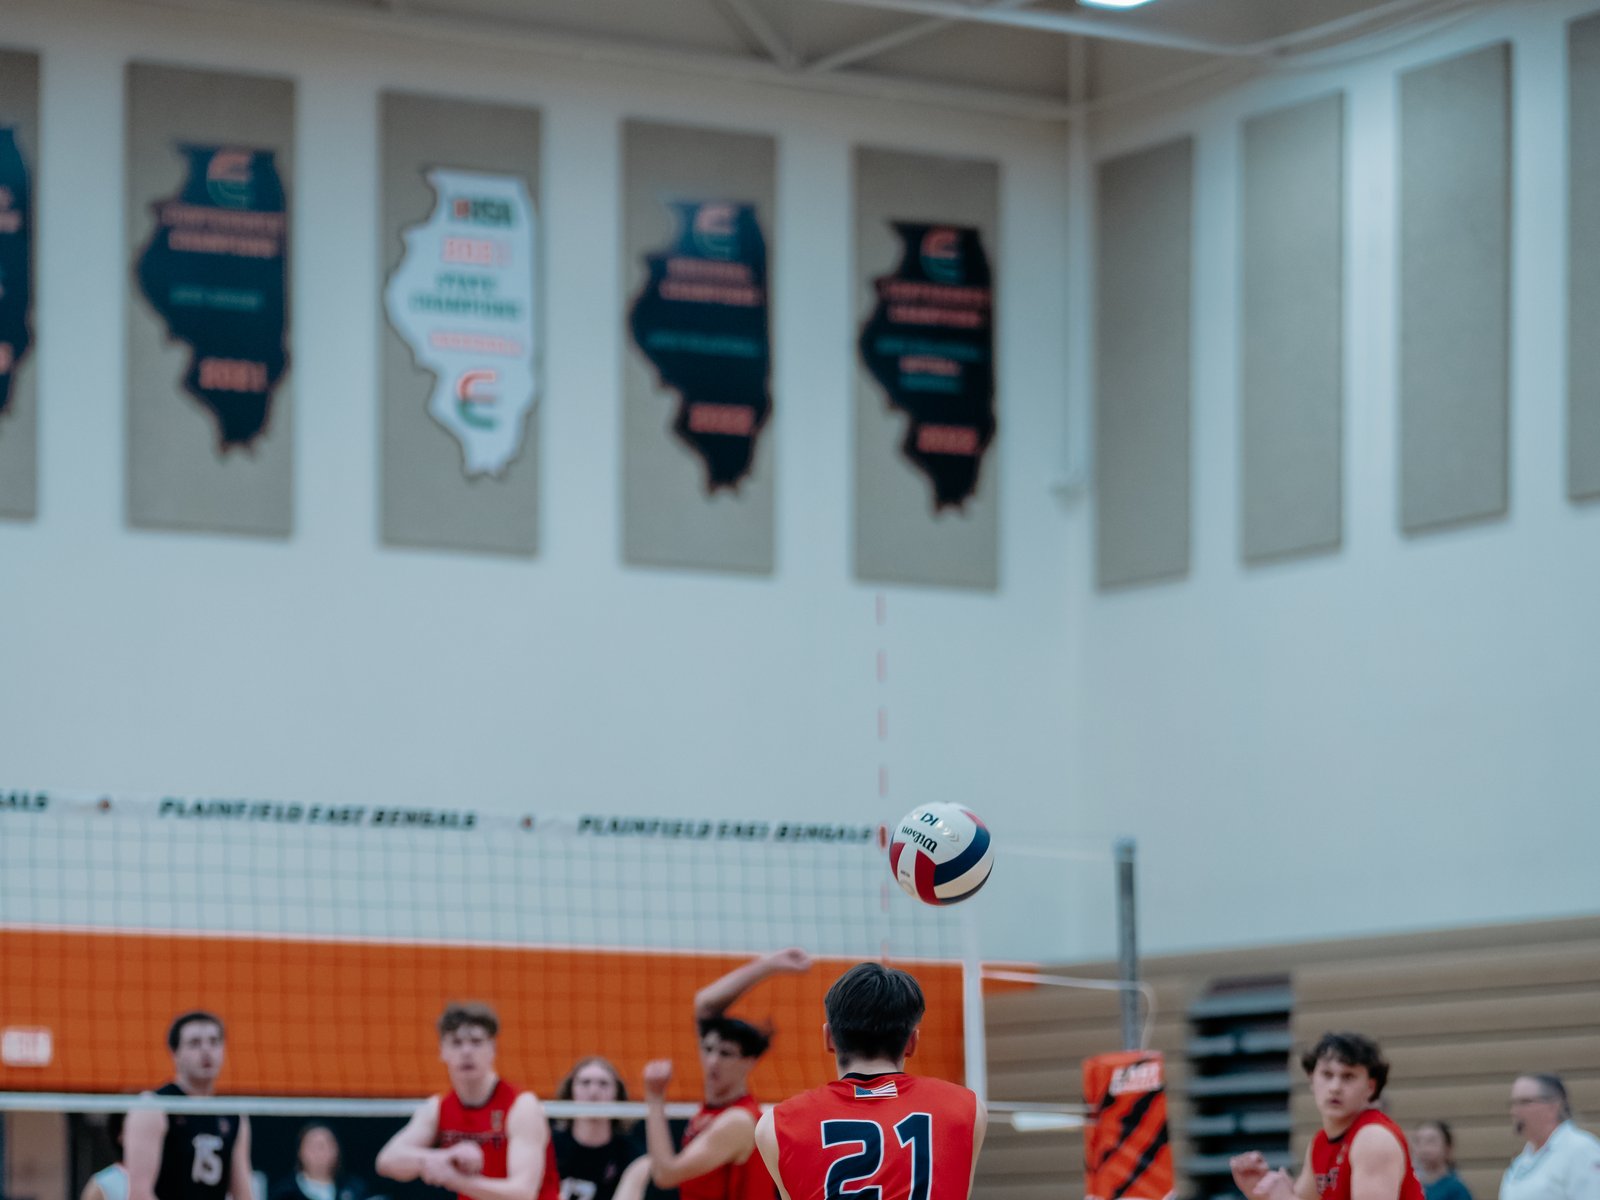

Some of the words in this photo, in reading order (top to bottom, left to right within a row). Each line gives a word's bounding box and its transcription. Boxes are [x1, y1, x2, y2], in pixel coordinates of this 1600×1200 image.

[159, 796, 304, 822] PLAINFIELD
[306, 802, 365, 826] EAST
[370, 804, 479, 830] BENGALS
[577, 813, 711, 839] PLAINFIELD
[714, 817, 771, 841] EAST
[773, 820, 873, 845] BENGALS
[901, 826, 938, 854] Wilson
[192, 1133, 224, 1186] 15
